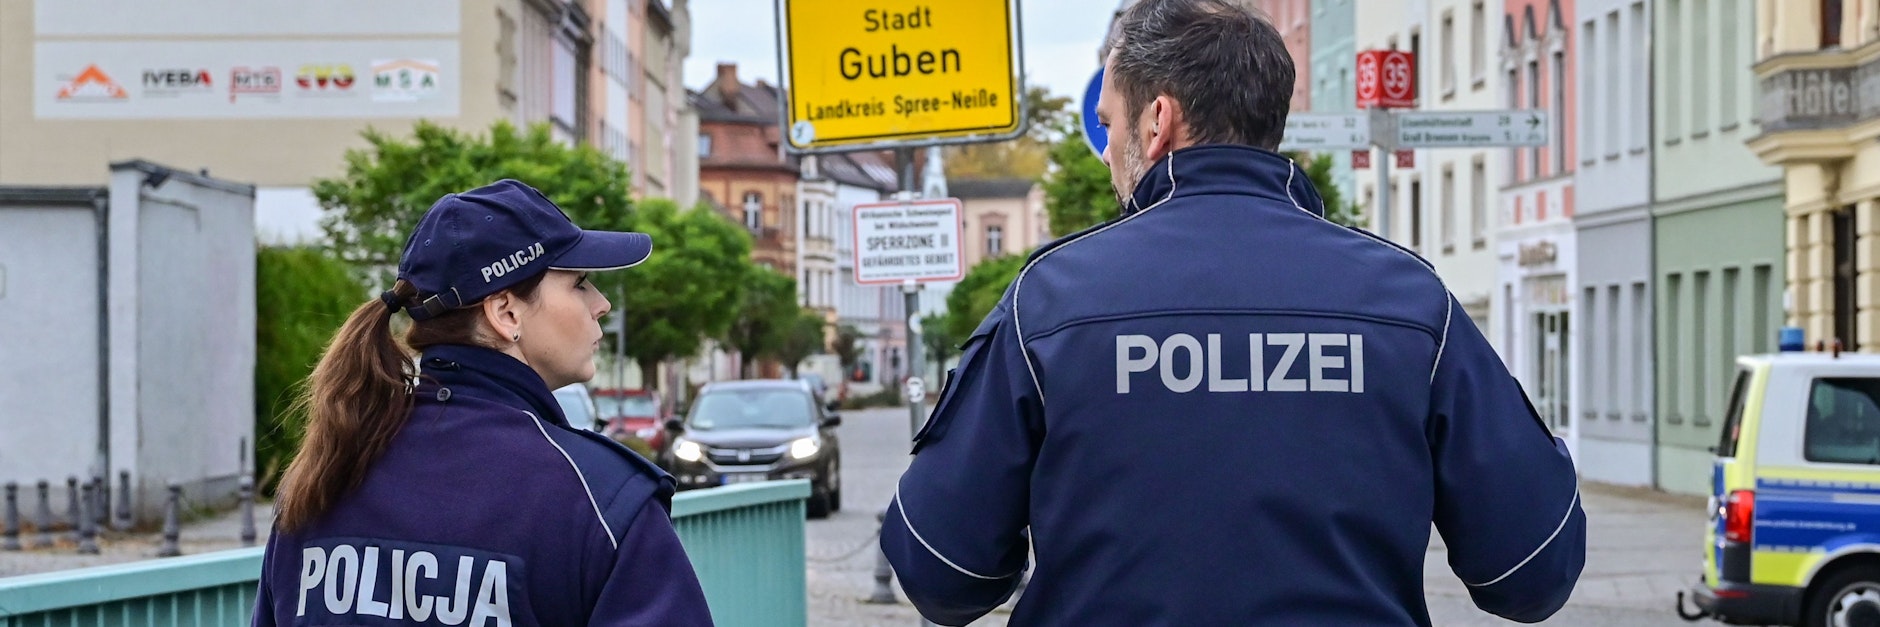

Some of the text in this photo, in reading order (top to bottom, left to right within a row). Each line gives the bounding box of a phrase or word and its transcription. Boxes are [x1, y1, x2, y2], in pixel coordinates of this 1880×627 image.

[864, 6, 932, 32] Stadt
[839, 43, 961, 80] Guben
[142, 69, 212, 87] IVEBA
[1360, 63, 1376, 88] 35
[1384, 63, 1408, 88] 35
[806, 89, 998, 121] Landkreis Spree-Neiße
[866, 233, 949, 251] SPERRZONE II
[481, 242, 545, 283] POLICJA
[862, 252, 954, 268] GEFÄHRDETES GEBIET
[1116, 333, 1364, 393] POLIZEI
[297, 544, 512, 627] POLICJA
